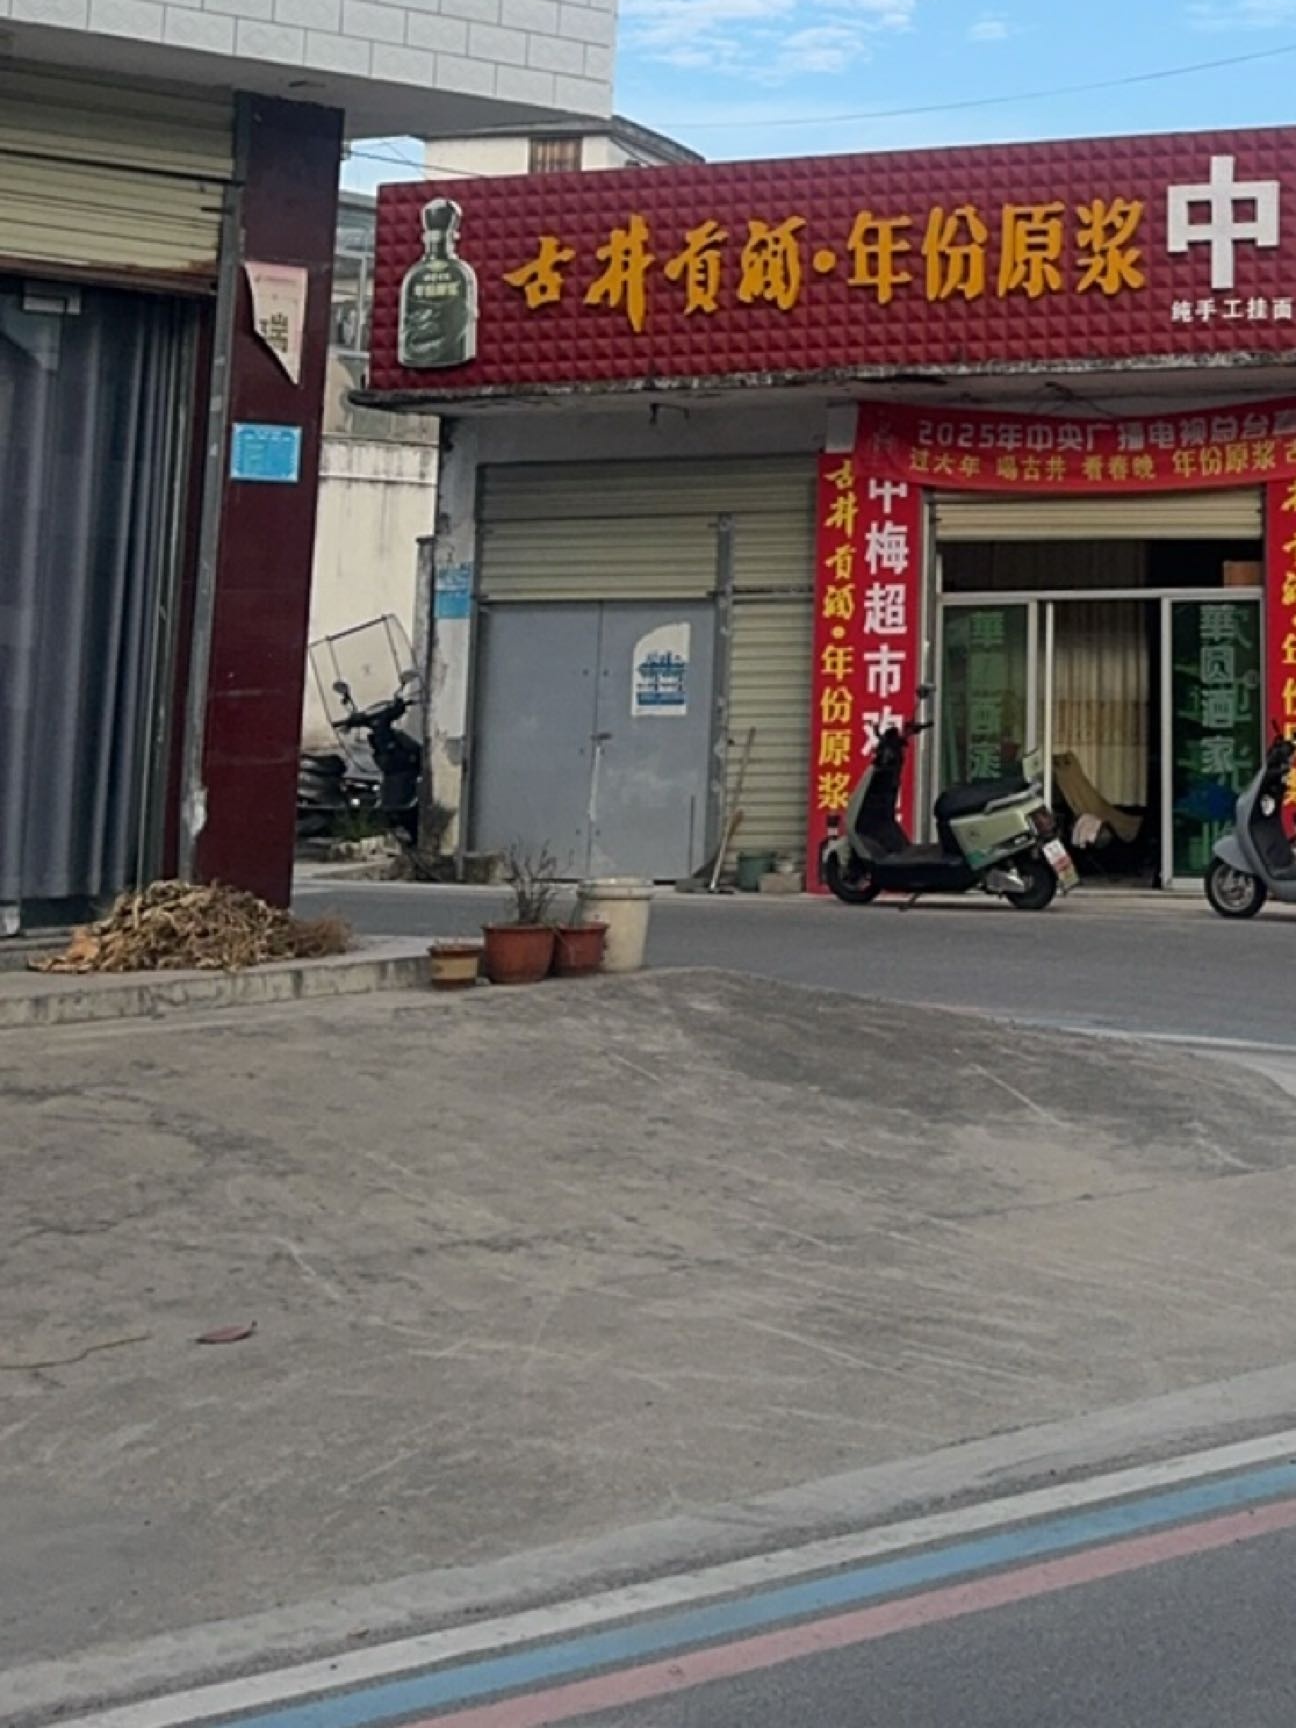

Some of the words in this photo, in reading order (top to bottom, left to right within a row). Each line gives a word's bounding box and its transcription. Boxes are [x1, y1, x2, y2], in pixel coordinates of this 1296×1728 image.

[1170, 295, 1295, 324] 纯手工挂面
[908, 445, 982, 479] 过大年
[995, 453, 1068, 481] 喝古井
[1080, 453, 1157, 481] 看春晚
